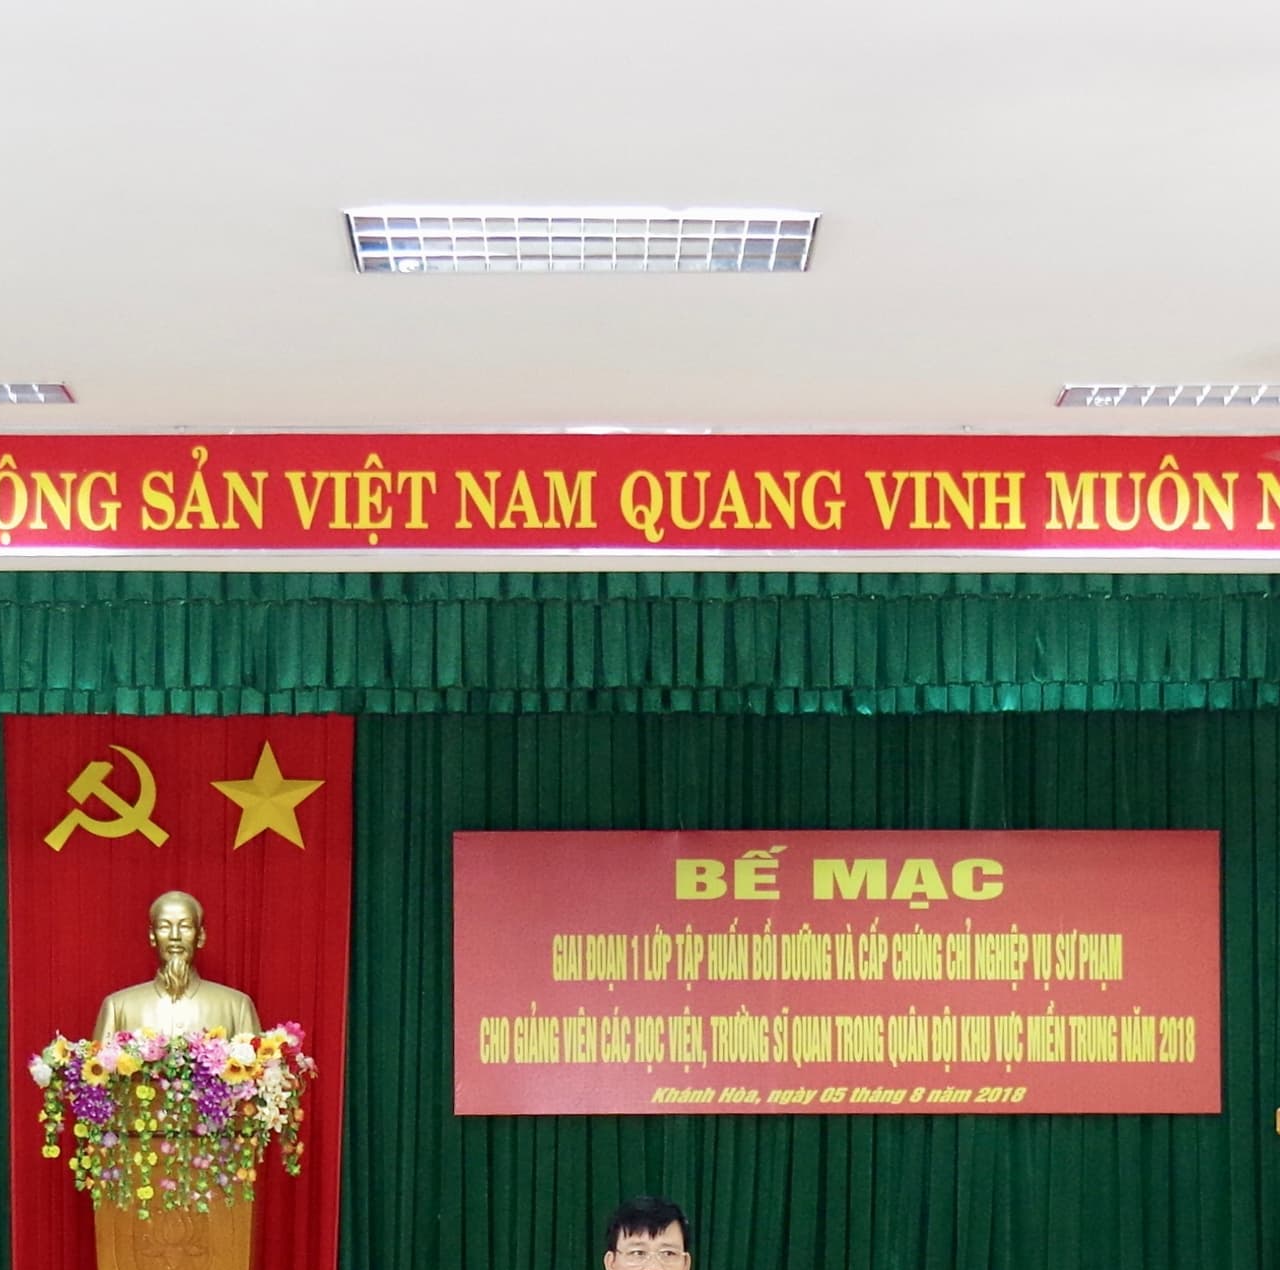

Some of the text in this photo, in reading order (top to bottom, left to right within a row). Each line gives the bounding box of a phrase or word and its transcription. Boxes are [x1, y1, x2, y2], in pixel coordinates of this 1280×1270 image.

[141, 446, 269, 531] SẢN
[284, 453, 436, 545] VIỆT
[455, 470, 597, 529] NAM
[620, 470, 846, 543] QUANG
[865, 471, 1027, 530] VINH
[1044, 454, 1239, 532] MUÔN
[675, 845, 1004, 910] BẾ MẠC
[552, 934, 583, 982] GIAI
[585, 933, 628, 992] ĐOẠN
[631, 935, 639, 981] 1
[643, 924, 673, 982] LỚP
[675, 924, 705, 991] TẬP
[707, 917, 750, 981] HUẤN
[834, 923, 856, 981] VÀ
[857, 916, 889, 982] CẤP
[891, 923, 944, 982] CHỨNG
[973, 923, 1030, 992] NGHIỆP
[1031, 932, 1053, 992] VỤ
[1054, 928, 1078, 981] SƯ
[1078, 933, 1124, 992] PHẠM
[479, 1015, 511, 1065] CHO
[512, 1000, 561, 1064] GIẢNG
[561, 1007, 600, 1064] VIÊN
[598, 1007, 633, 1064] CÁC
[633, 1015, 666, 1073] HỌC
[666, 1006, 708, 1073] VIỆN,
[709, 1004, 771, 1064] TRƯỜNG
[791, 1015, 833, 1068] QUAN
[834, 1014, 885, 1063] TRONG
[887, 1005, 930, 1068] QUÂN
[930, 1005, 959, 1073] ĐỘI
[959, 1014, 993, 1063] KHU
[993, 1010, 1025, 1073] VỰC
[1067, 1014, 1119, 1063] TRUNG
[1120, 1006, 1158, 1063] NĂM
[1158, 1015, 1196, 1064] 2018
[650, 1086, 1028, 1106] Khánh Hòa, ngày 05 tháng 8 năm 2018
